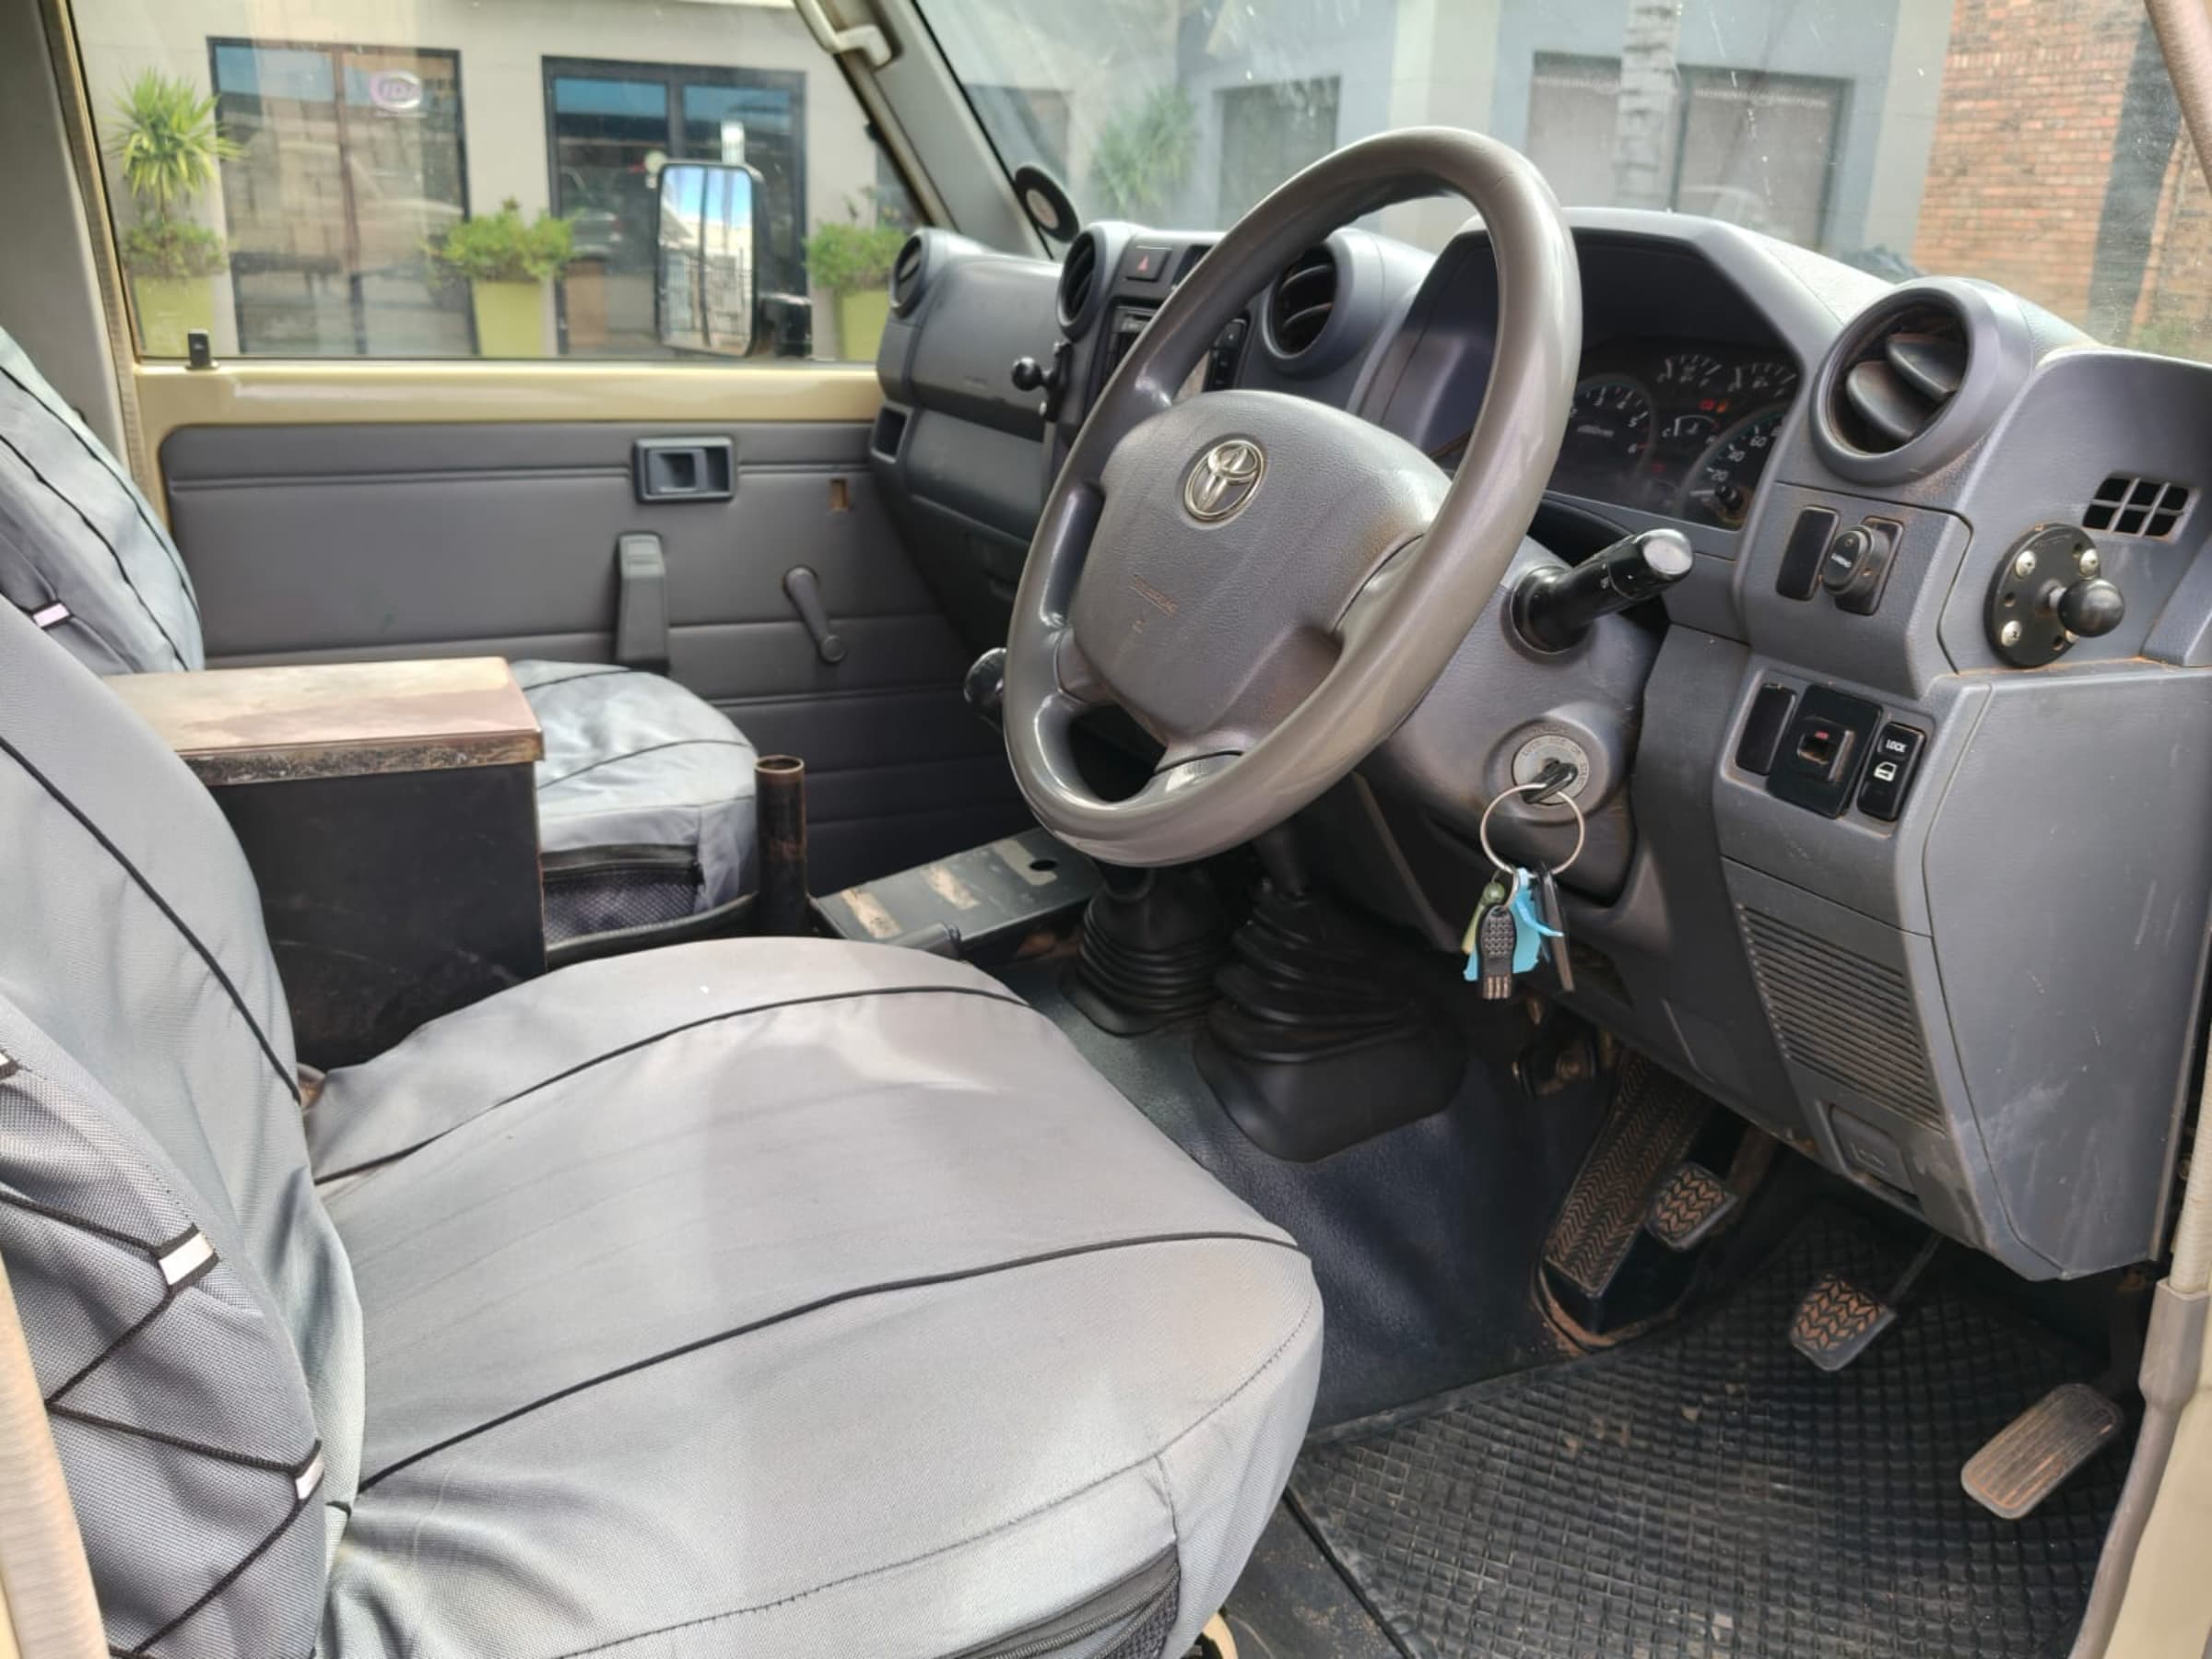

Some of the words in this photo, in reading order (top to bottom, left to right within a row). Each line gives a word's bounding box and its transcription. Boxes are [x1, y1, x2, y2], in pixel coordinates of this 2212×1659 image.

[1627, 416, 1639, 429] 5
[1749, 435, 1768, 448] 60
[1711, 469, 1730, 482] 20
[1885, 738, 1907, 753] LOCK
